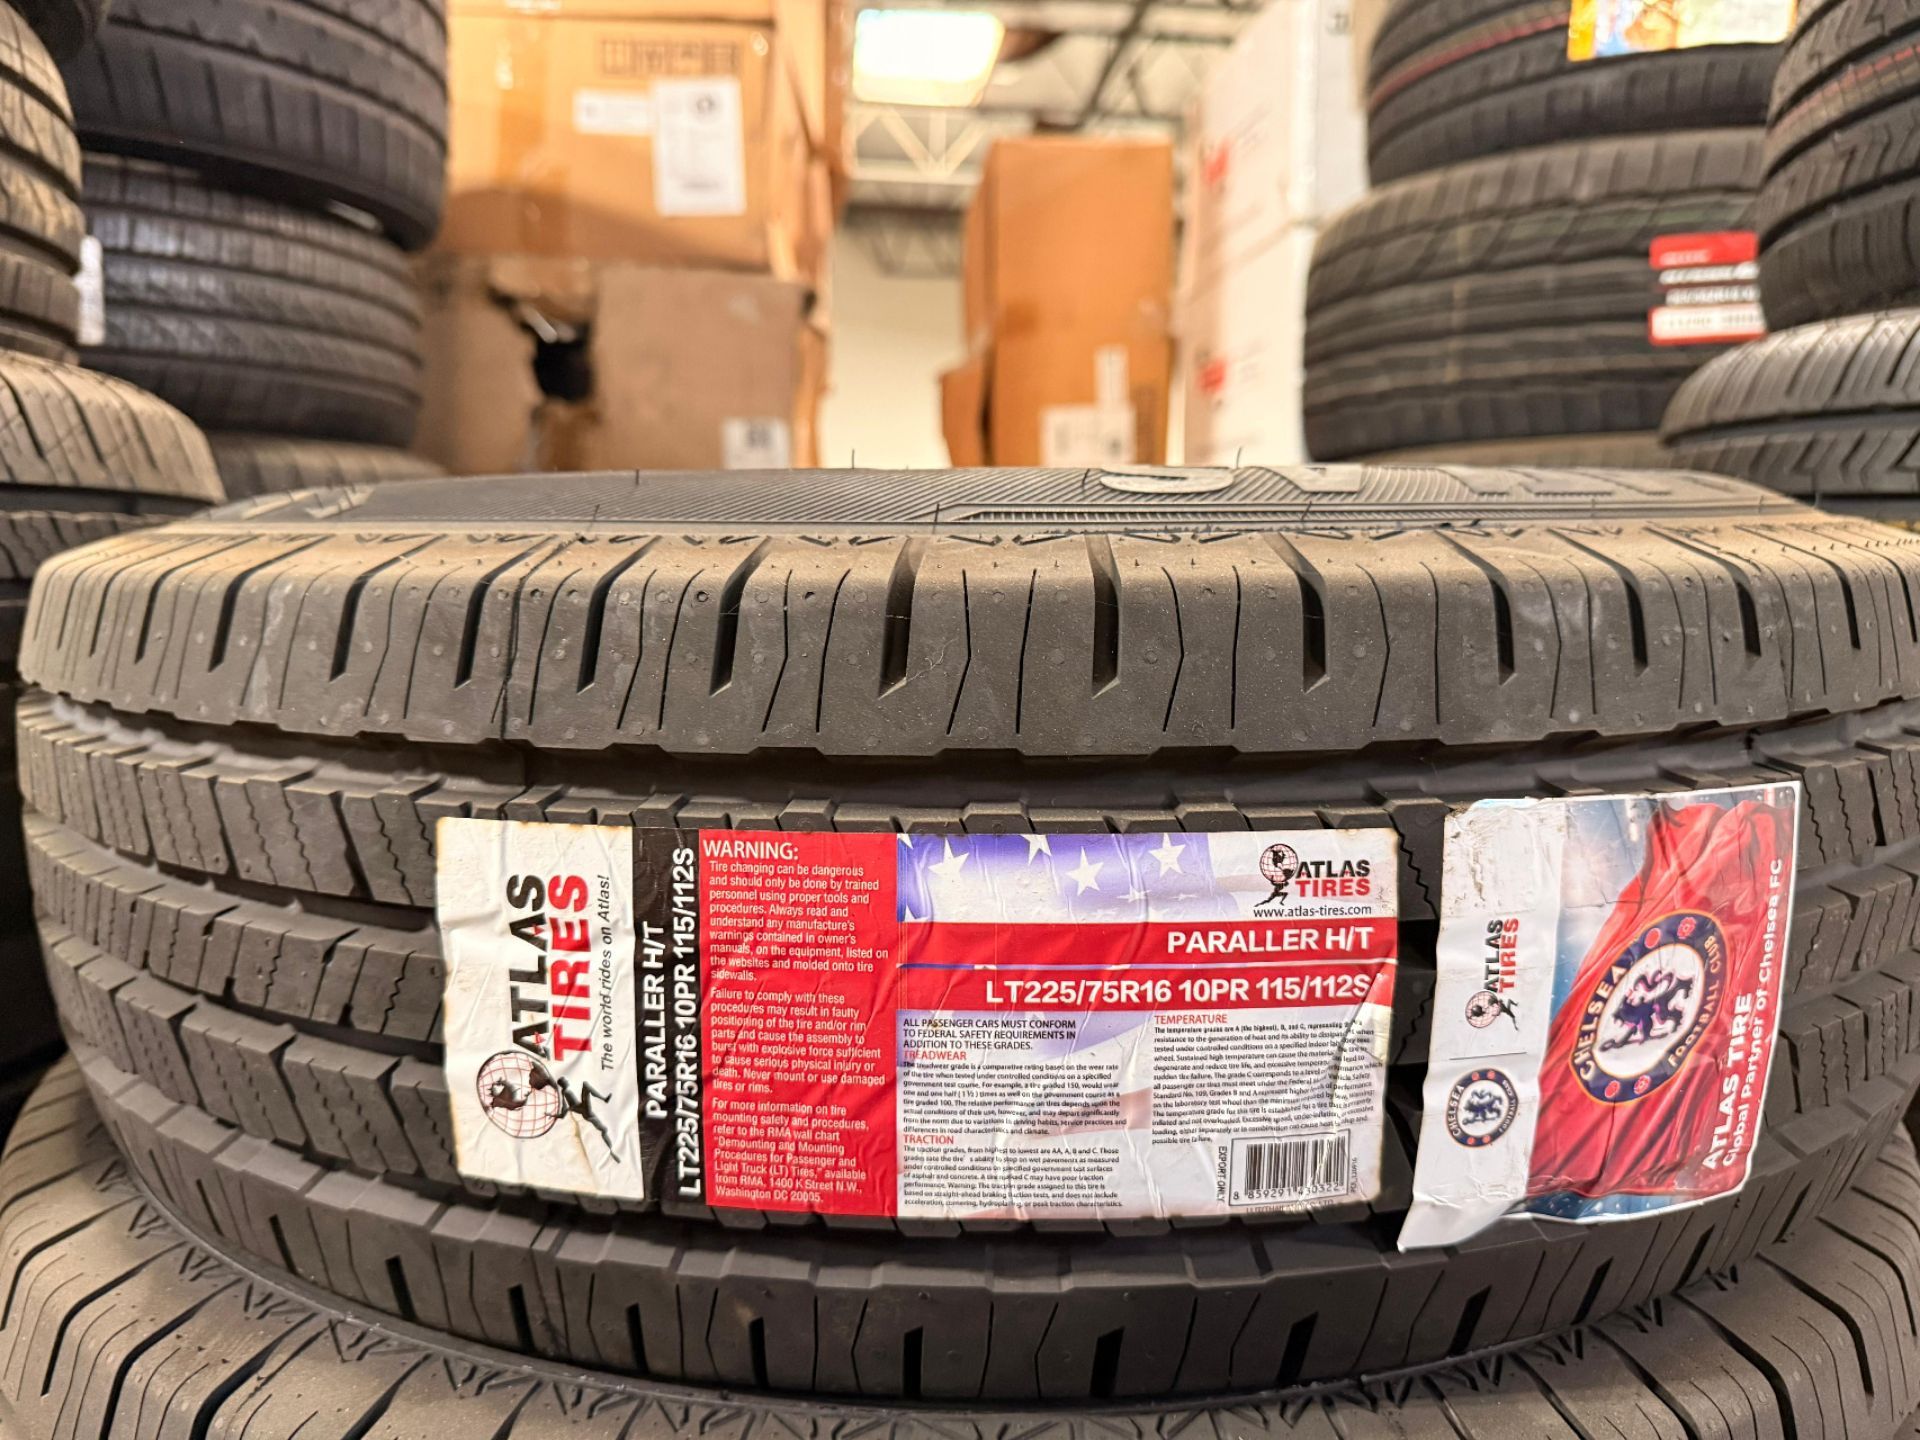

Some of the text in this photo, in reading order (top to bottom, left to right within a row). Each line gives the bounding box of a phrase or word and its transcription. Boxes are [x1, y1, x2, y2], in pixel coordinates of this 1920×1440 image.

[702, 839, 798, 861] WARNING:
[709, 860, 864, 879] Tire changing can be dangerous
[1296, 859, 1370, 878] ATLAS
[709, 874, 879, 892] and should only be done by trained
[1296, 878, 1370, 898] TIRES
[709, 888, 869, 905] personnel using proper tools and
[768, 904, 804, 918] Always
[806, 905, 828, 917] read
[830, 906, 848, 917] and
[1252, 904, 1372, 918] www.atlas-tires.com
[710, 915, 784, 931] understand any
[756, 930, 803, 943] contained
[806, 932, 815, 943] in
[818, 932, 856, 945] owner's
[1168, 926, 1373, 954] PARALLER H/T
[756, 944, 888, 959] on the listed on
[1484, 919, 1503, 992] ATLAS
[1500, 918, 1520, 994] TIRES
[506, 875, 550, 1062] ATLAS
[548, 874, 592, 1062] TIRES
[710, 955, 873, 972] the websites and molded onto tire
[597, 875, 614, 1072] The world rides on Atlas!
[708, 987, 844, 1004] Failure comply these
[986, 974, 1369, 1005] LT225/75R16 10PR 115/112S
[1668, 935, 1721, 1068] FOOTBALL CLUB
[767, 1006, 788, 1018] may
[790, 1004, 818, 1016] result
[820, 1005, 830, 1017] in
[1154, 1014, 1227, 1024] TEMPERATURE
[1722, 858, 1783, 1166] Global Partner of Chelsea FC
[641, 921, 666, 1119] PARALLER H/T
[673, 848, 701, 1198] LT225/75R16 10PR 115/112S
[766, 1017, 847, 1031] of tire and/or
[922, 1020, 973, 1028] PASSENGER
[976, 1020, 999, 1028] CARS
[1001, 1020, 1027, 1028] MUST
[1029, 1020, 1076, 1028] CONFORM
[1574, 965, 1626, 1081] CHELSEA
[711, 1028, 736, 1042] parts
[737, 1029, 756, 1041] and
[806, 1031, 852, 1047] assembly
[855, 1033, 865, 1045] to
[918, 1029, 957, 1038] FEDERAL
[994, 1031, 1064, 1039] REQUIREMENTS
[1066, 1031, 1076, 1039] IN
[761, 1043, 806, 1058] explosive
[808, 1045, 834, 1057] force
[904, 1040, 947, 1048] ADDITION
[965, 1041, 992, 1049] THESE
[994, 1042, 1032, 1050] GRADES.
[711, 1054, 722, 1065] to
[754, 1055, 789, 1068] serious
[791, 1057, 831, 1072] physical
[864, 1062, 875, 1071] or
[904, 1050, 966, 1060] TREADWEAR
[743, 1068, 771, 1080] Never
[807, 1073, 818, 1082] or
[821, 1074, 838, 1083] use
[840, 1072, 885, 1087] damaged
[1702, 992, 1752, 1169] ATLAS TIRE
[734, 1083, 746, 1092] or
[748, 1081, 772, 1093] rims.
[712, 1099, 846, 1115] For more information on tire
[1448, 1085, 1464, 1136] CHELSEA
[712, 1112, 808, 1129] mounting safety and
[713, 1124, 840, 1140] refer to RMA wall chart
[904, 1134, 954, 1144] TRACTION
[778, 1140, 844, 1156] and Mounting
[714, 1150, 856, 1168] Procedures for Passenger and
[1218, 1146, 1228, 1178] EXPORT
[742, 1164, 767, 1176] Truck
[824, 1167, 866, 1180] available
[715, 1174, 833, 1190] from 1400 Street
[715, 1187, 788, 1202] Washington DC
[1248, 1188, 1291, 1199] 859291
